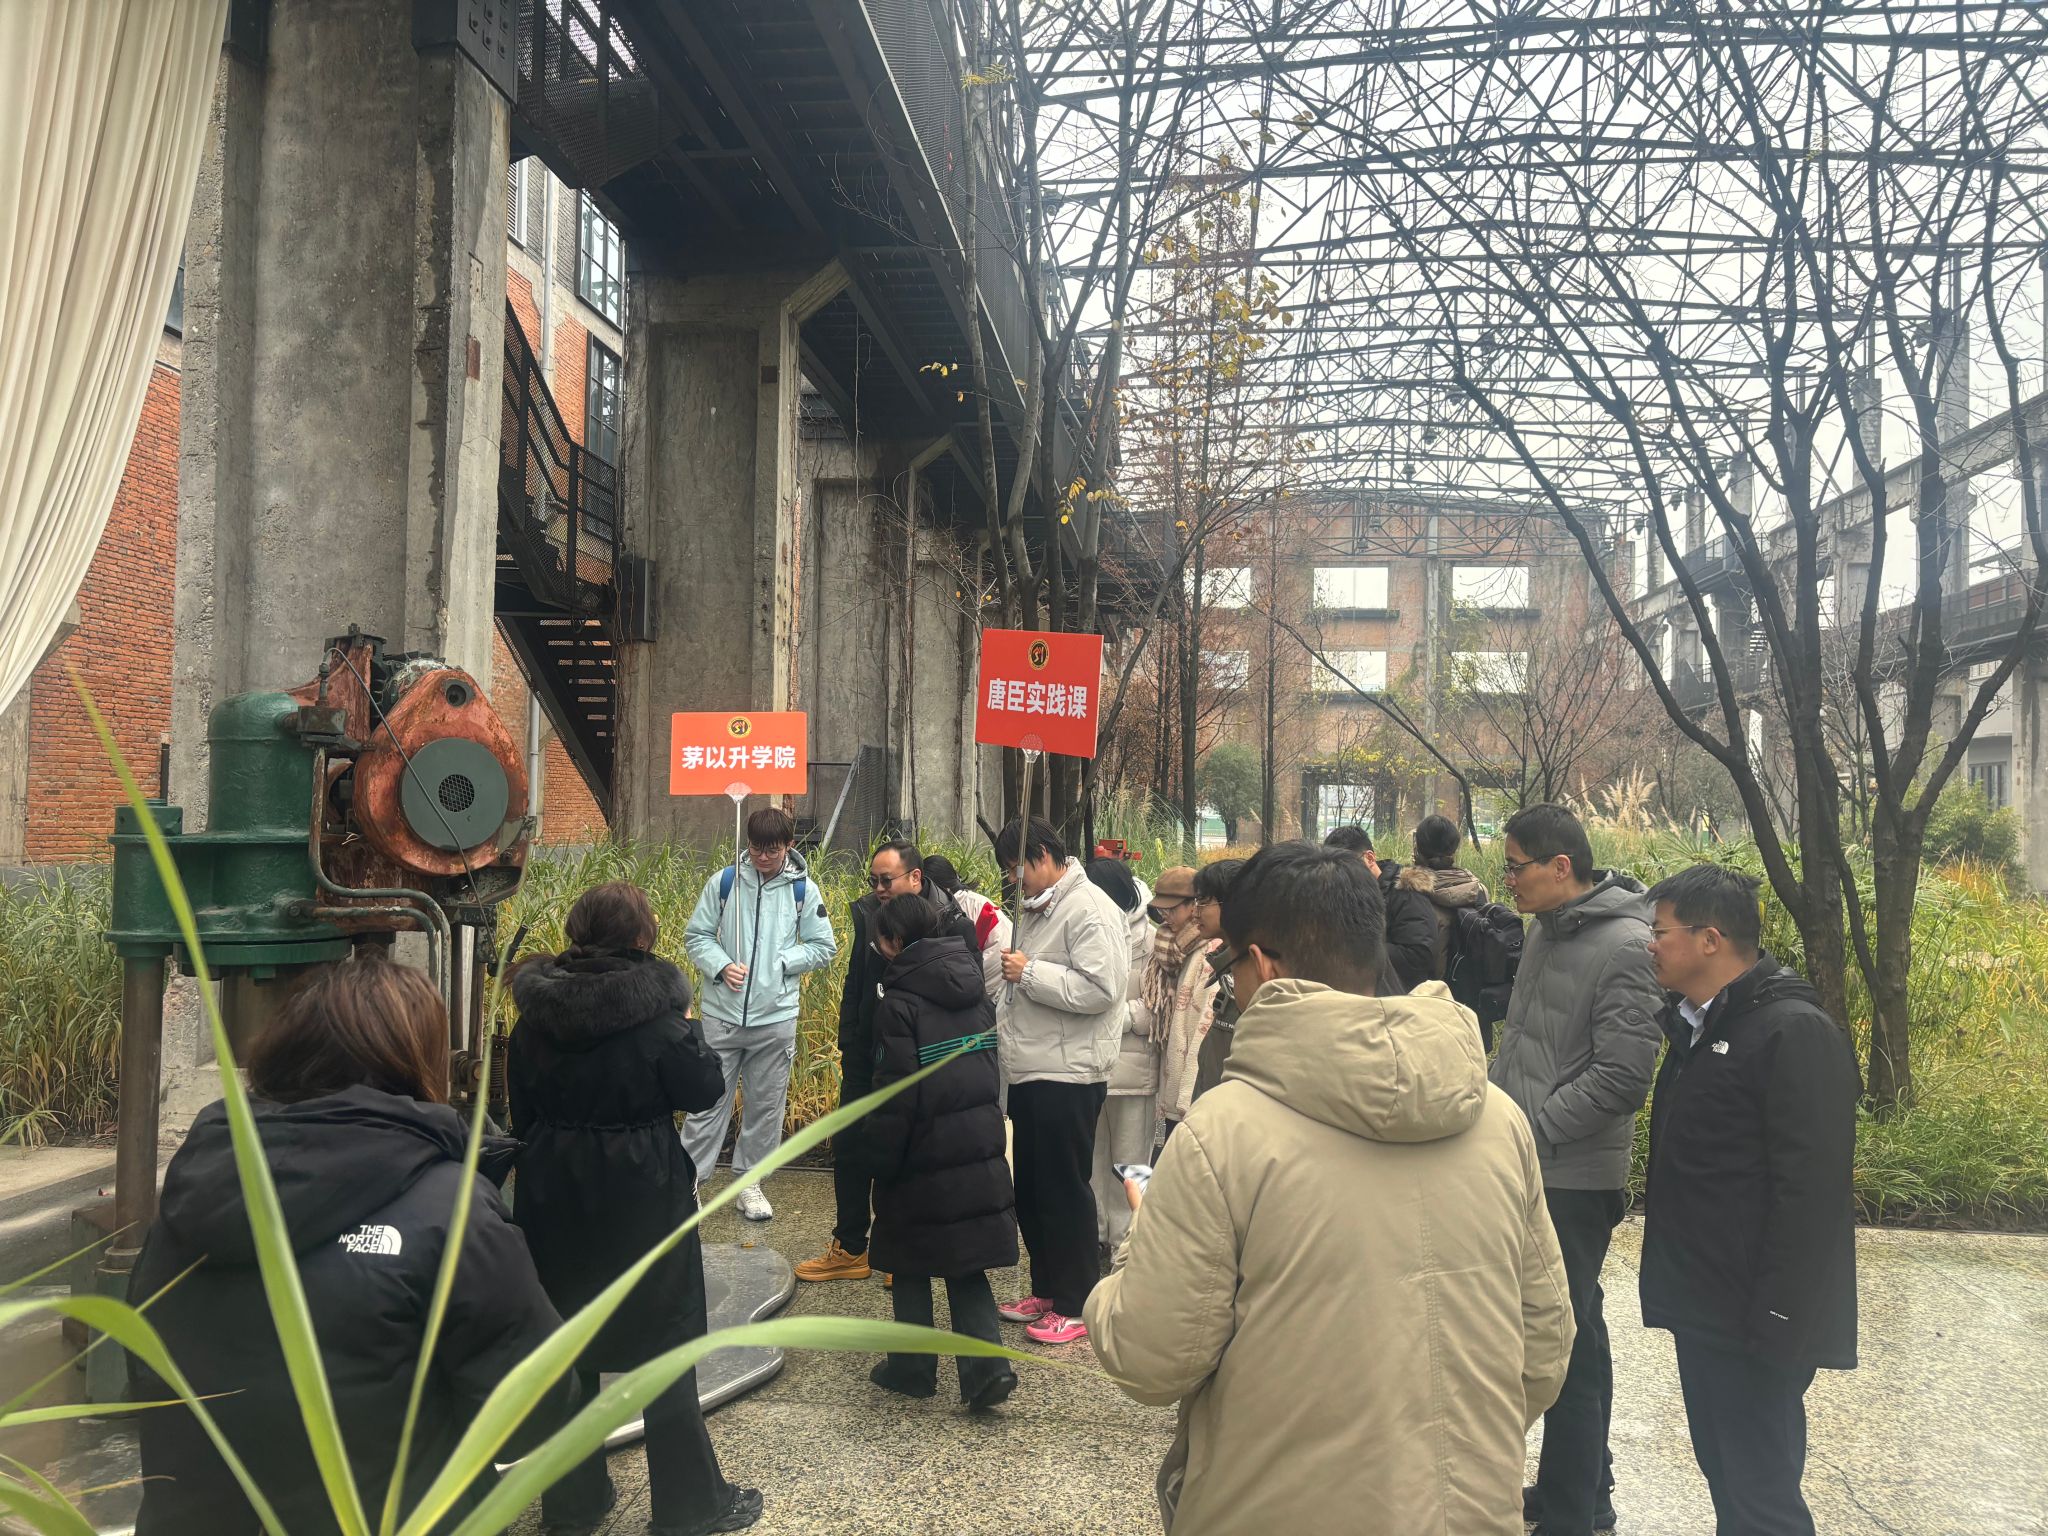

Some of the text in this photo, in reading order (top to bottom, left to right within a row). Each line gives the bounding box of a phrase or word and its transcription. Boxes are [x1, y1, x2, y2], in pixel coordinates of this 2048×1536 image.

[987, 678, 1088, 719] 唐臣实践课
[681, 745, 796, 769] 茅以升学院
[360, 1224, 384, 1235] THE
[338, 1233, 381, 1245] NORTH
[346, 1243, 378, 1254] FACE
